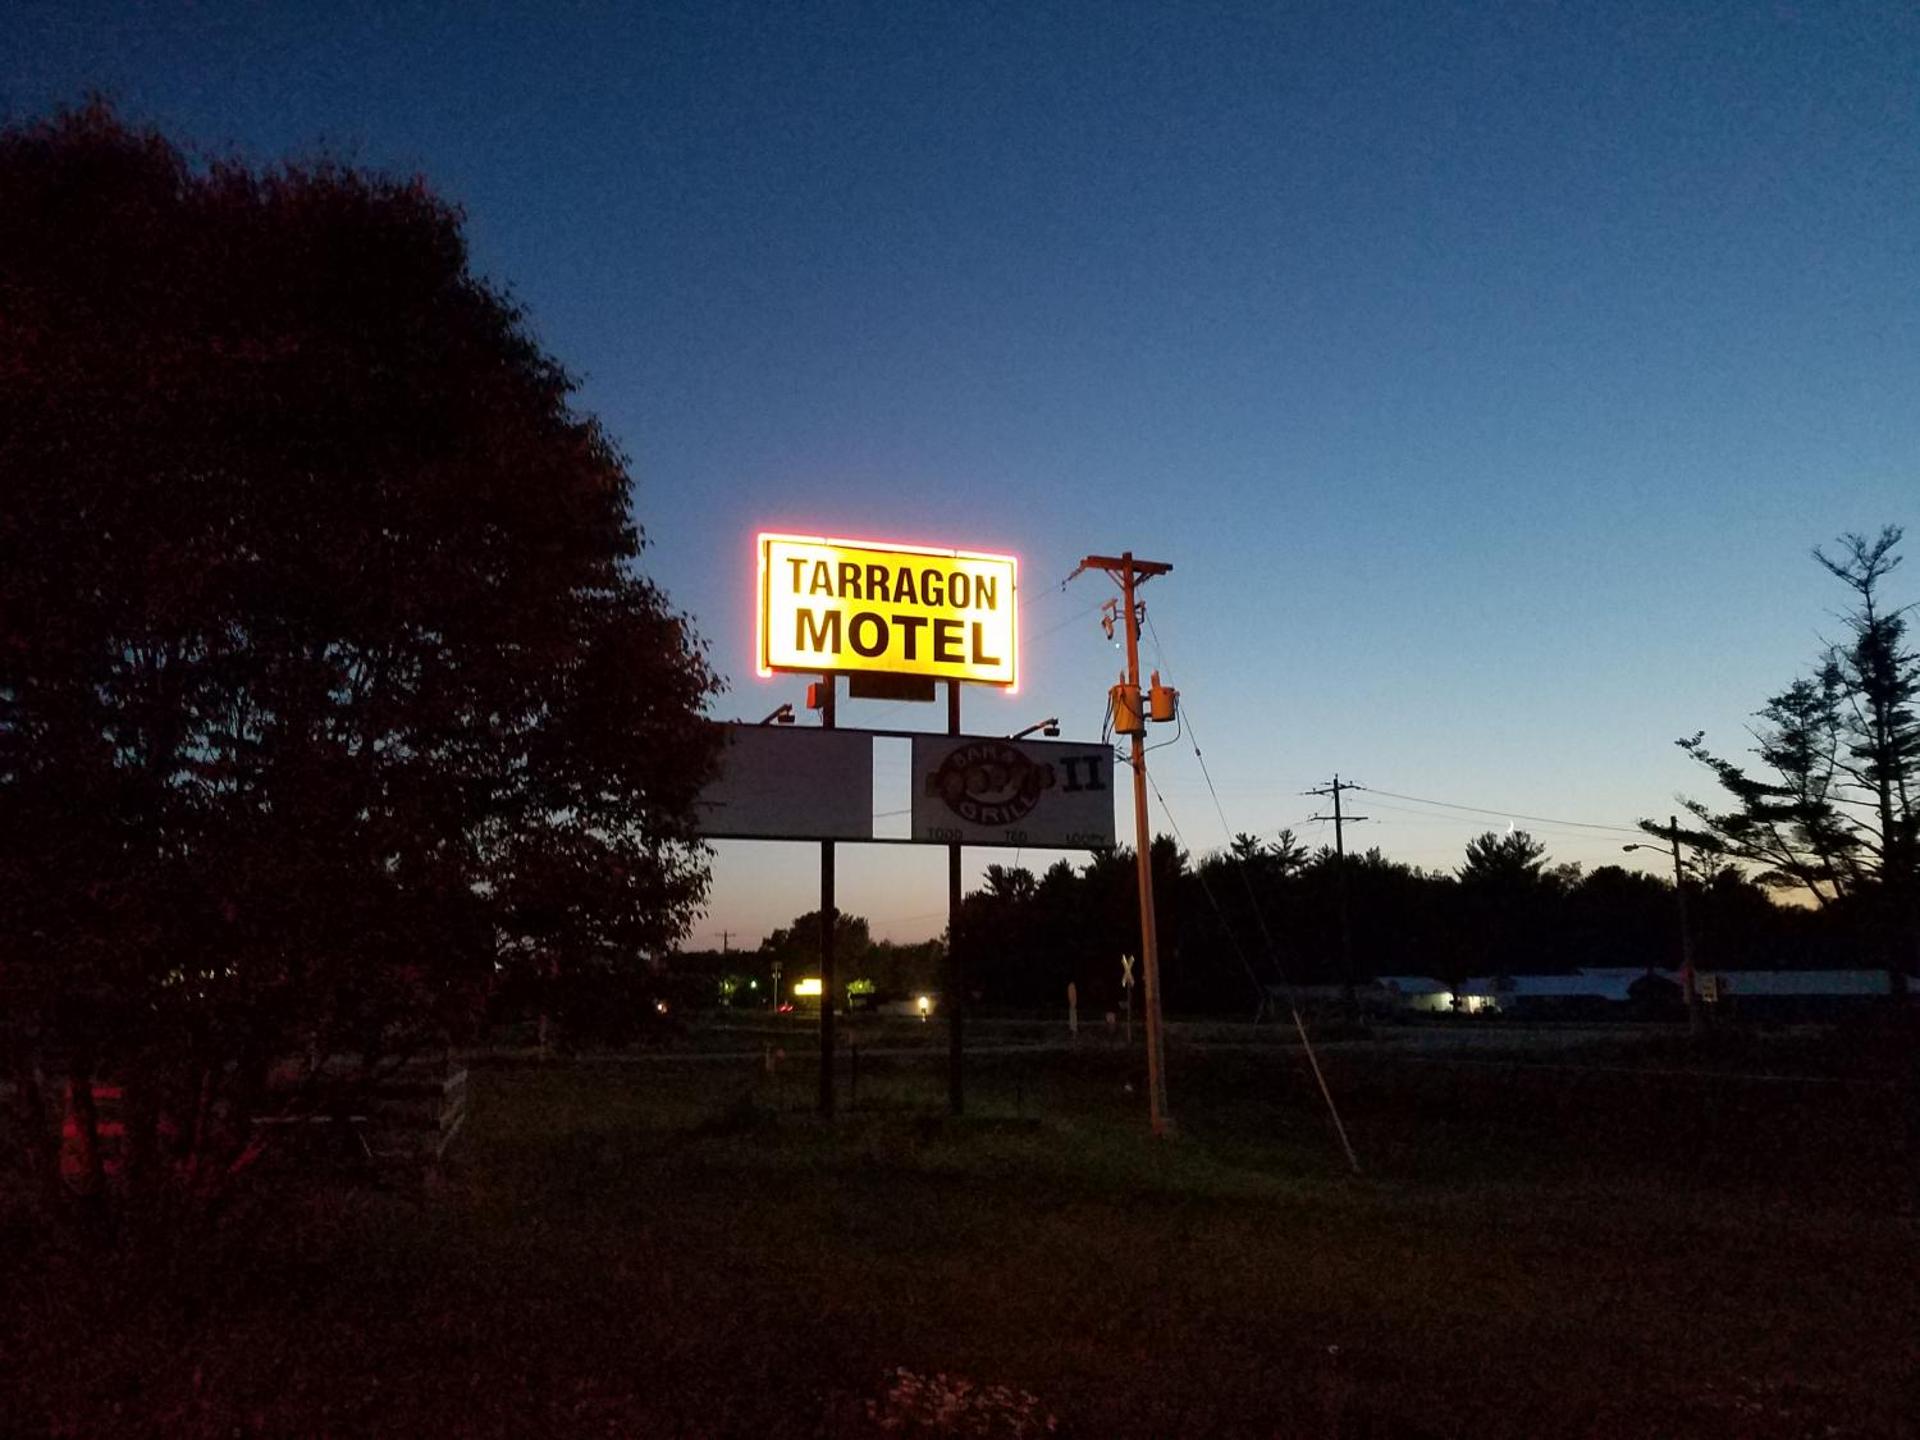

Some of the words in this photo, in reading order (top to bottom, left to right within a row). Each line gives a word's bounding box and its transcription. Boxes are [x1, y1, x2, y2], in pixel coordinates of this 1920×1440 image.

[787, 558, 996, 610] TARRAGON
[796, 608, 1000, 665] MOTEL
[1060, 756, 1106, 792] II
[960, 791, 1036, 824] GRILL
